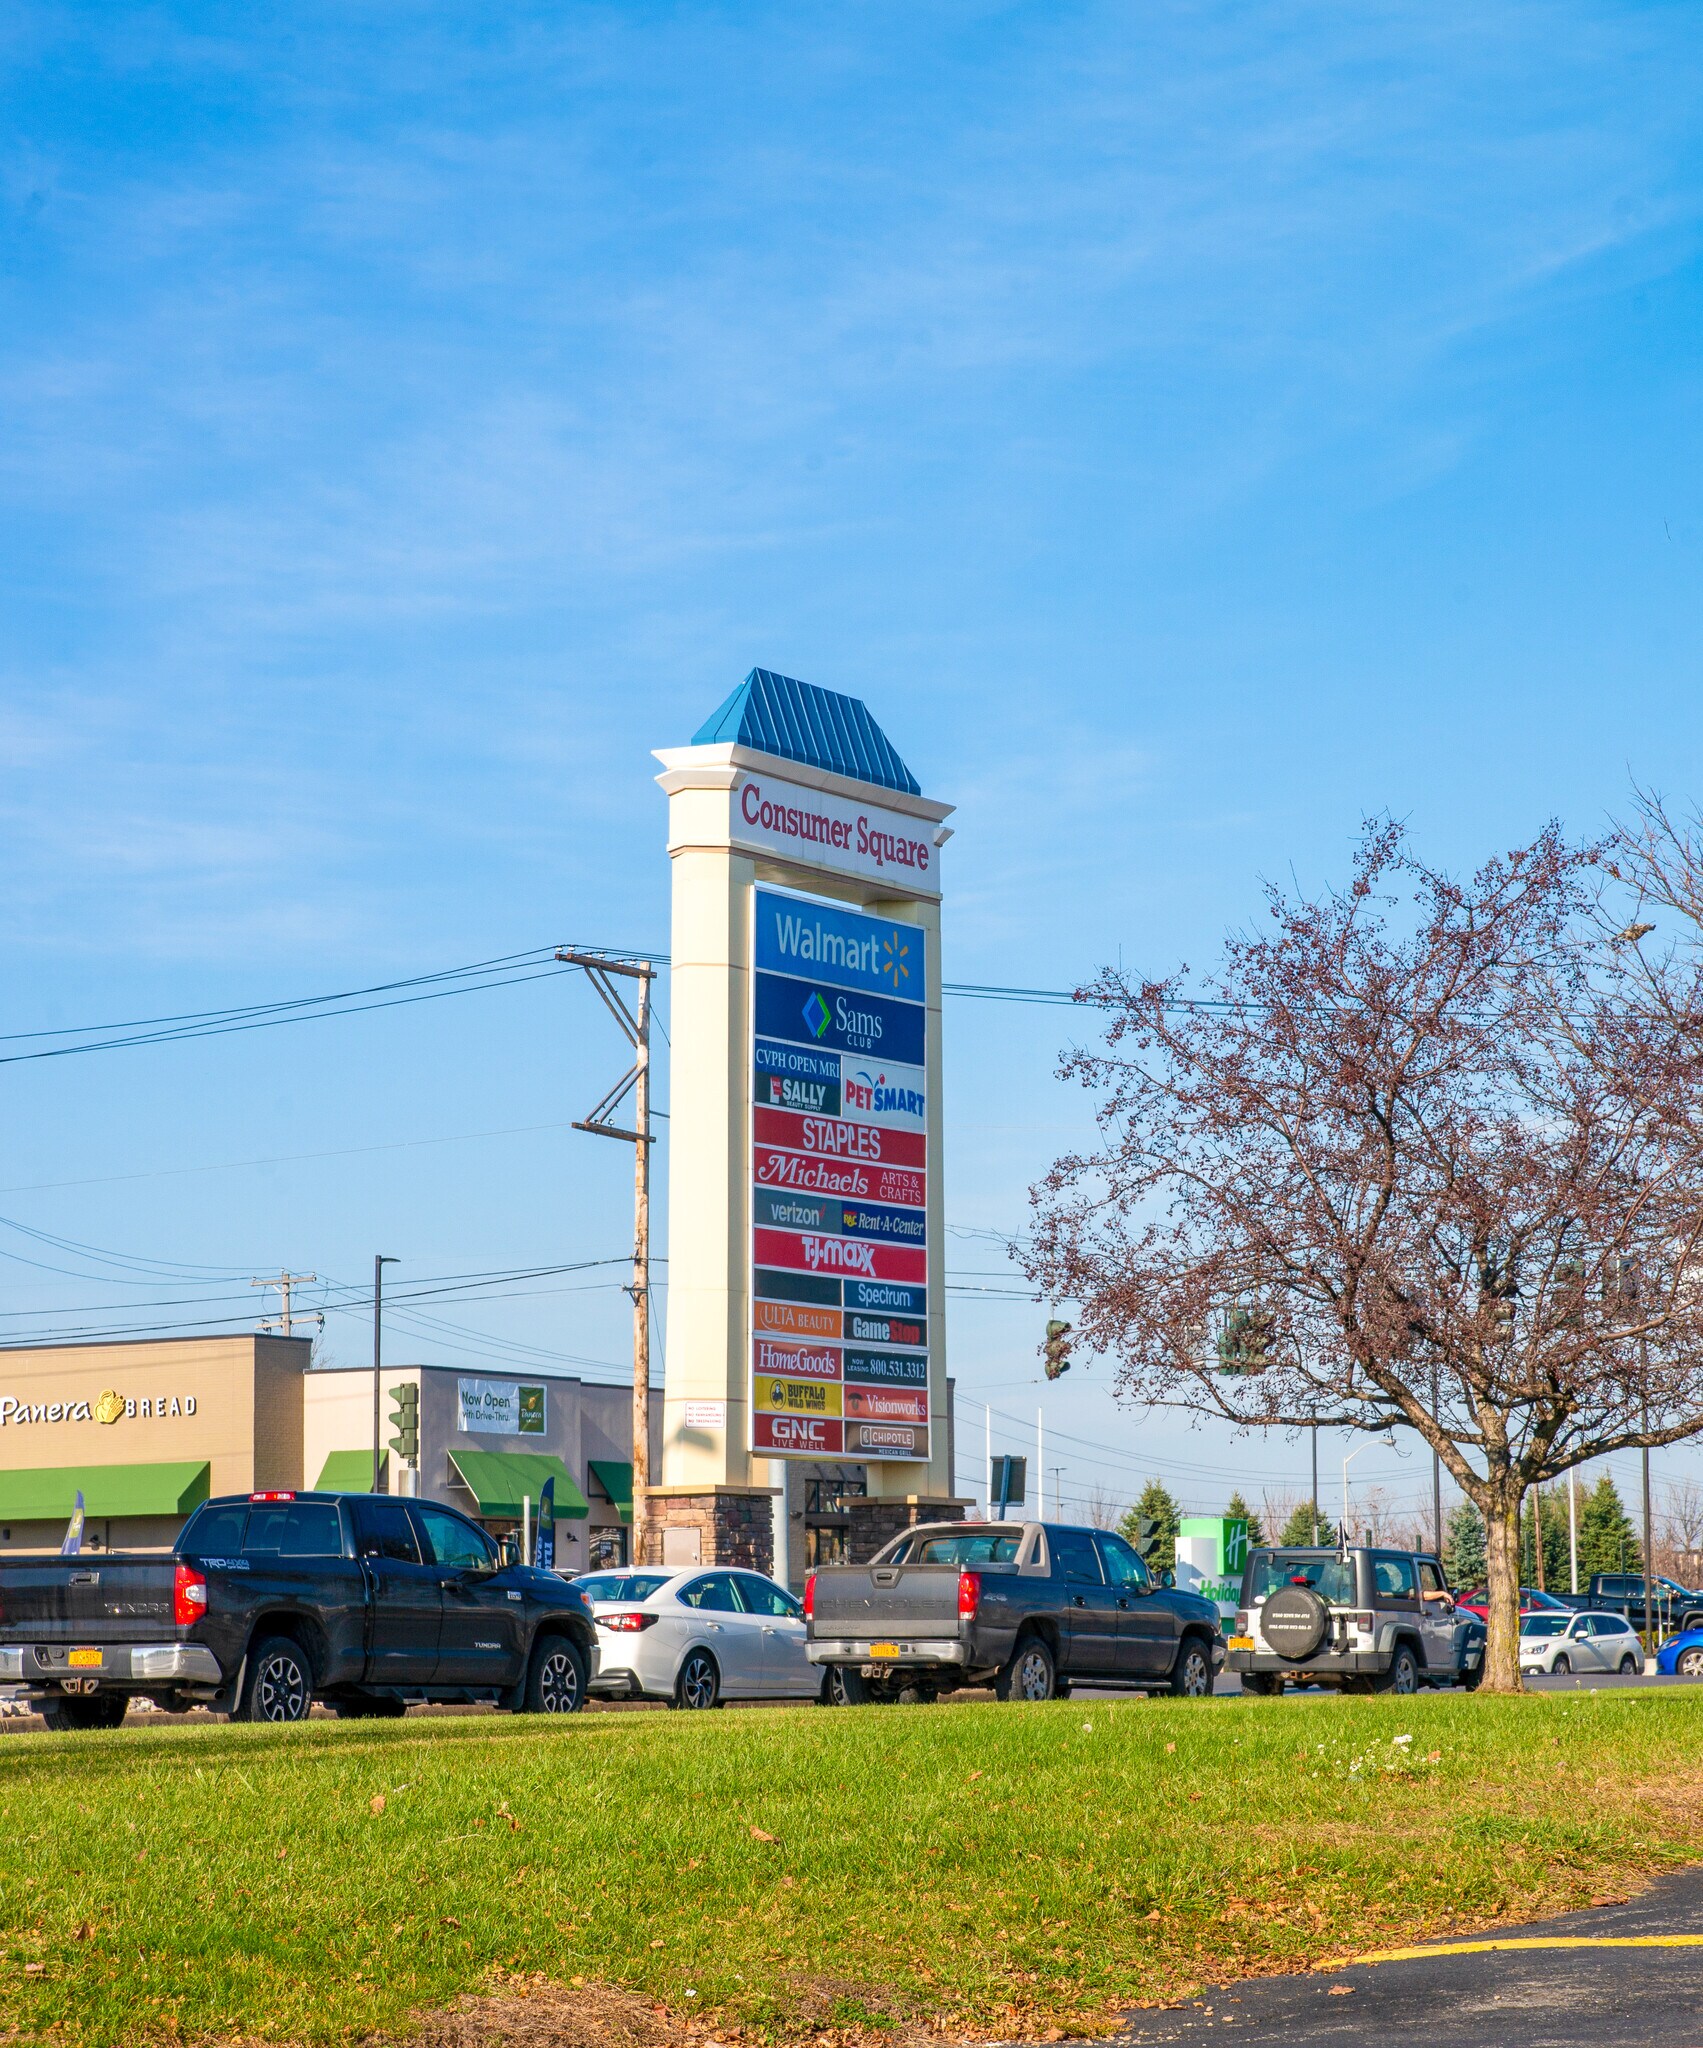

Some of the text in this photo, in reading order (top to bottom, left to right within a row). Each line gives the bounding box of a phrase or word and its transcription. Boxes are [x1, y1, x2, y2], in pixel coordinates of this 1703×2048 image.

[741, 783, 929, 871] Consumer Square
[775, 912, 880, 975] Walmart
[836, 996, 883, 1039] Sams
[847, 1034, 872, 1049] CLUB
[755, 1048, 840, 1079] CVPH OPEN MRI
[782, 1079, 826, 1106] SALLY
[786, 1100, 822, 1112] BEAUTY SUPPLY
[802, 1117, 881, 1160] STAPLES
[758, 1154, 869, 1195] Michaels
[881, 1171, 919, 1188] ARTS &
[879, 1185, 922, 1203] CRAFTS
[771, 1201, 819, 1226] verizon
[858, 1283, 911, 1307] Spectrum
[763, 1305, 835, 1331] ULTA BEAUTY
[853, 1316, 920, 1345] GameStop
[759, 1343, 836, 1375] HomeGoods
[847, 1365, 869, 1373] LEASING
[852, 1358, 864, 1366] NOW
[870, 1358, 925, 1379] 800.531.3312
[461, 1391, 511, 1410] Now Open
[787, 1383, 826, 1400] BUFFALO
[0, 1395, 197, 1425] Panera BREAD
[787, 1397, 826, 1411] WILD WINGS
[866, 1394, 926, 1416] Visionworks
[771, 1417, 826, 1442] GNC
[872, 1431, 912, 1445] CHIPOTLE
[772, 1438, 826, 1450] LIVE WELL
[878, 1448, 912, 1457] MEXICAN GRILL
[199, 1558, 227, 1569] TRD
[821, 1598, 951, 1609] CHEVROLET
[1199, 1579, 1241, 1607] Holiday
[104, 1602, 170, 1614] TUNDRA
[474, 1641, 501, 1649] TUNDRA
